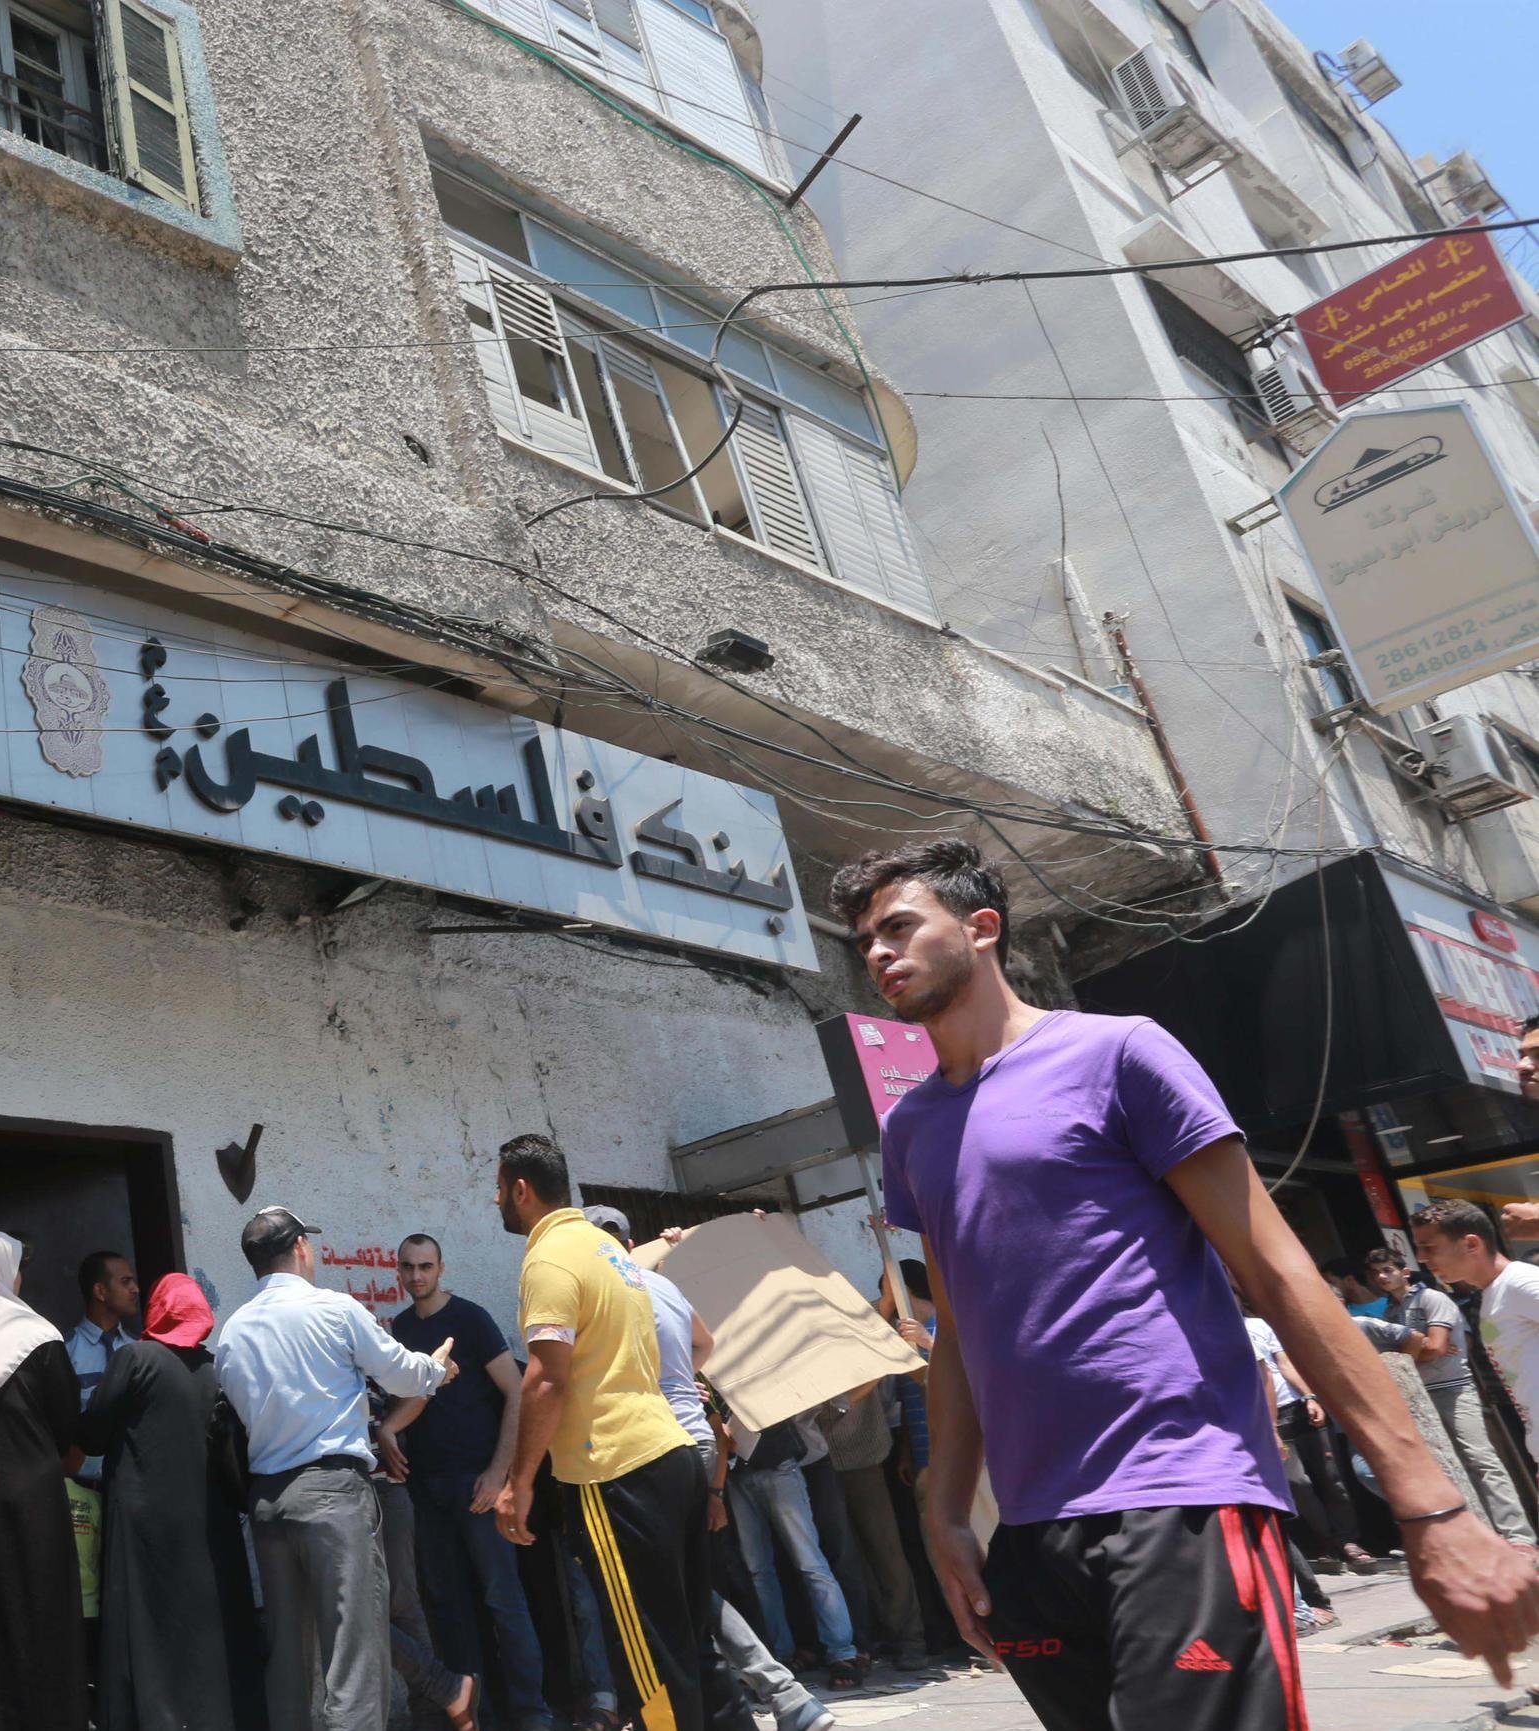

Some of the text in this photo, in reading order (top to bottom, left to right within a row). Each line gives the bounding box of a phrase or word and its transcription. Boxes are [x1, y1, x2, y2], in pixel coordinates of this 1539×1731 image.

[184, 676, 795, 936] بنك فلسطين
[1174, 1659, 1234, 1672] adidas
